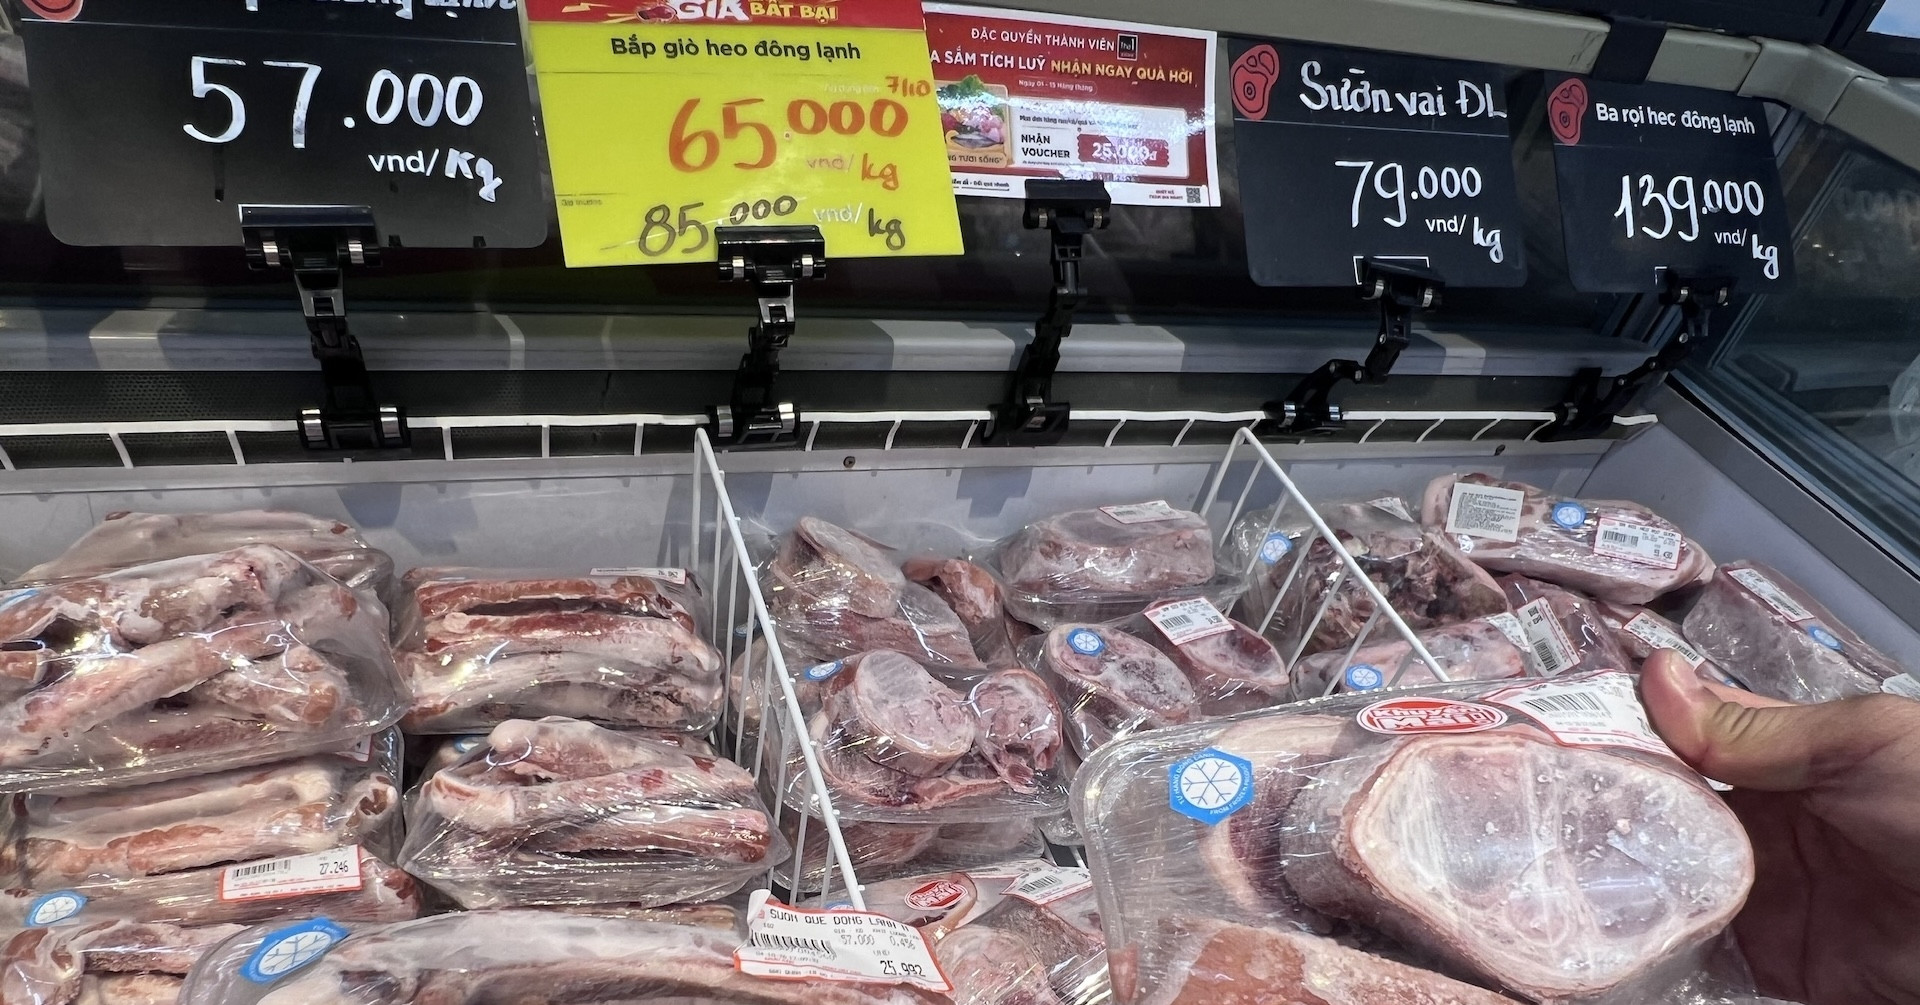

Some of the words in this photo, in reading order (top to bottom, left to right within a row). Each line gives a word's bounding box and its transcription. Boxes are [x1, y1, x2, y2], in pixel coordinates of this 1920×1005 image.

[800, 5, 837, 23] BẠI
[611, 33, 656, 59] Bắp
[663, 36, 699, 59] giò
[706, 39, 748, 57] heo
[754, 39, 811, 61] đông
[816, 41, 861, 63] lạnh
[971, 26, 997, 42] ĐẶC
[1001, 28, 1041, 44] QUYỀN
[1045, 33, 1085, 48] THÀNH
[1088, 37, 1115, 51] VIÊN
[945, 45, 976, 65] SẮM
[980, 51, 1014, 68] TÍCH
[1018, 54, 1046, 71] LUỸ
[1051, 58, 1091, 78] NHẬN
[1095, 64, 1132, 78] NGAY
[1136, 66, 1165, 81] QUÀ
[1169, 67, 1193, 84] HỜI
[183, 56, 484, 148] 57.000
[1395, 84, 1447, 117] vai
[1455, 79, 1507, 118] ĐL
[668, 98, 909, 173] 65.000
[1595, 102, 1618, 122] Ba
[1622, 105, 1644, 127] rọi
[1681, 110, 1721, 134] đông
[1722, 113, 1755, 136] lạnh
[1021, 132, 1051, 146] NHẬN
[1022, 147, 1070, 158] VOUCHER
[1335, 160, 1482, 228] 79.000
[1614, 174, 1764, 242] 139.000
[638, 195, 798, 257] 85.000
[319, 860, 349, 876] 27.246
[880, 959, 927, 978] 25.992
